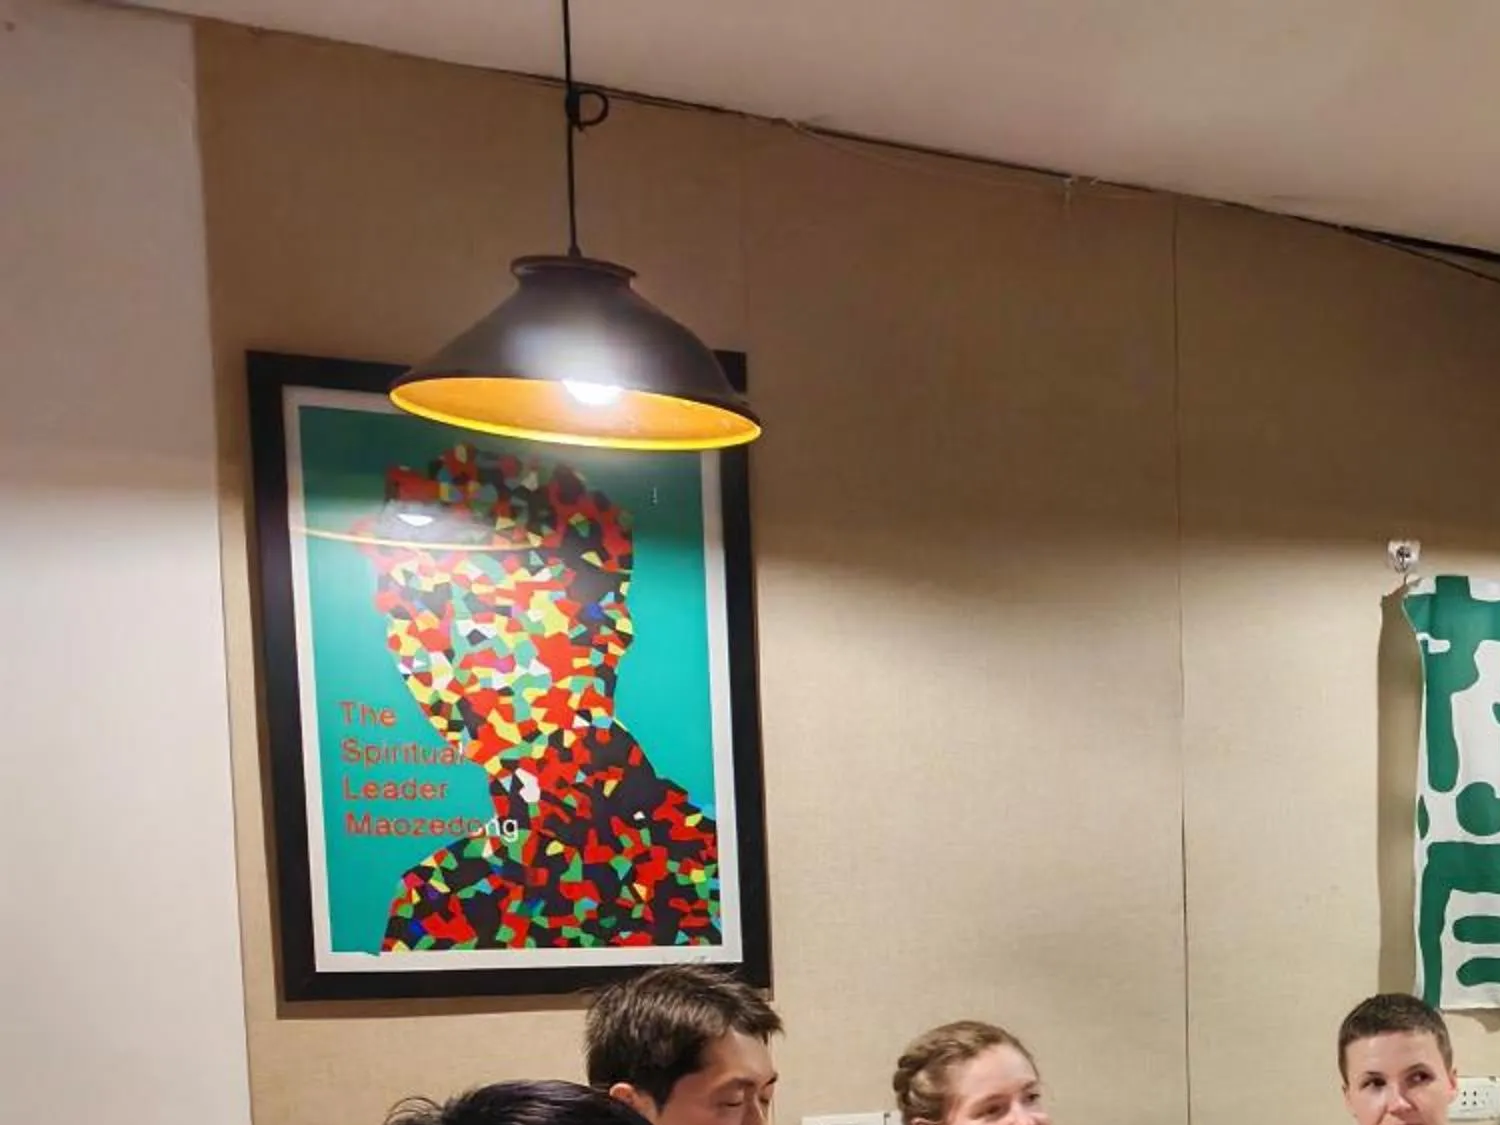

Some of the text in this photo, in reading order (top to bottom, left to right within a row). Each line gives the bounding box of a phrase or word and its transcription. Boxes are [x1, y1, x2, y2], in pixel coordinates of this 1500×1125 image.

[340, 701, 396, 727] The
[341, 737, 466, 769] Spiritual
[343, 775, 449, 801] Leader
[345, 812, 519, 842] Maozedong
